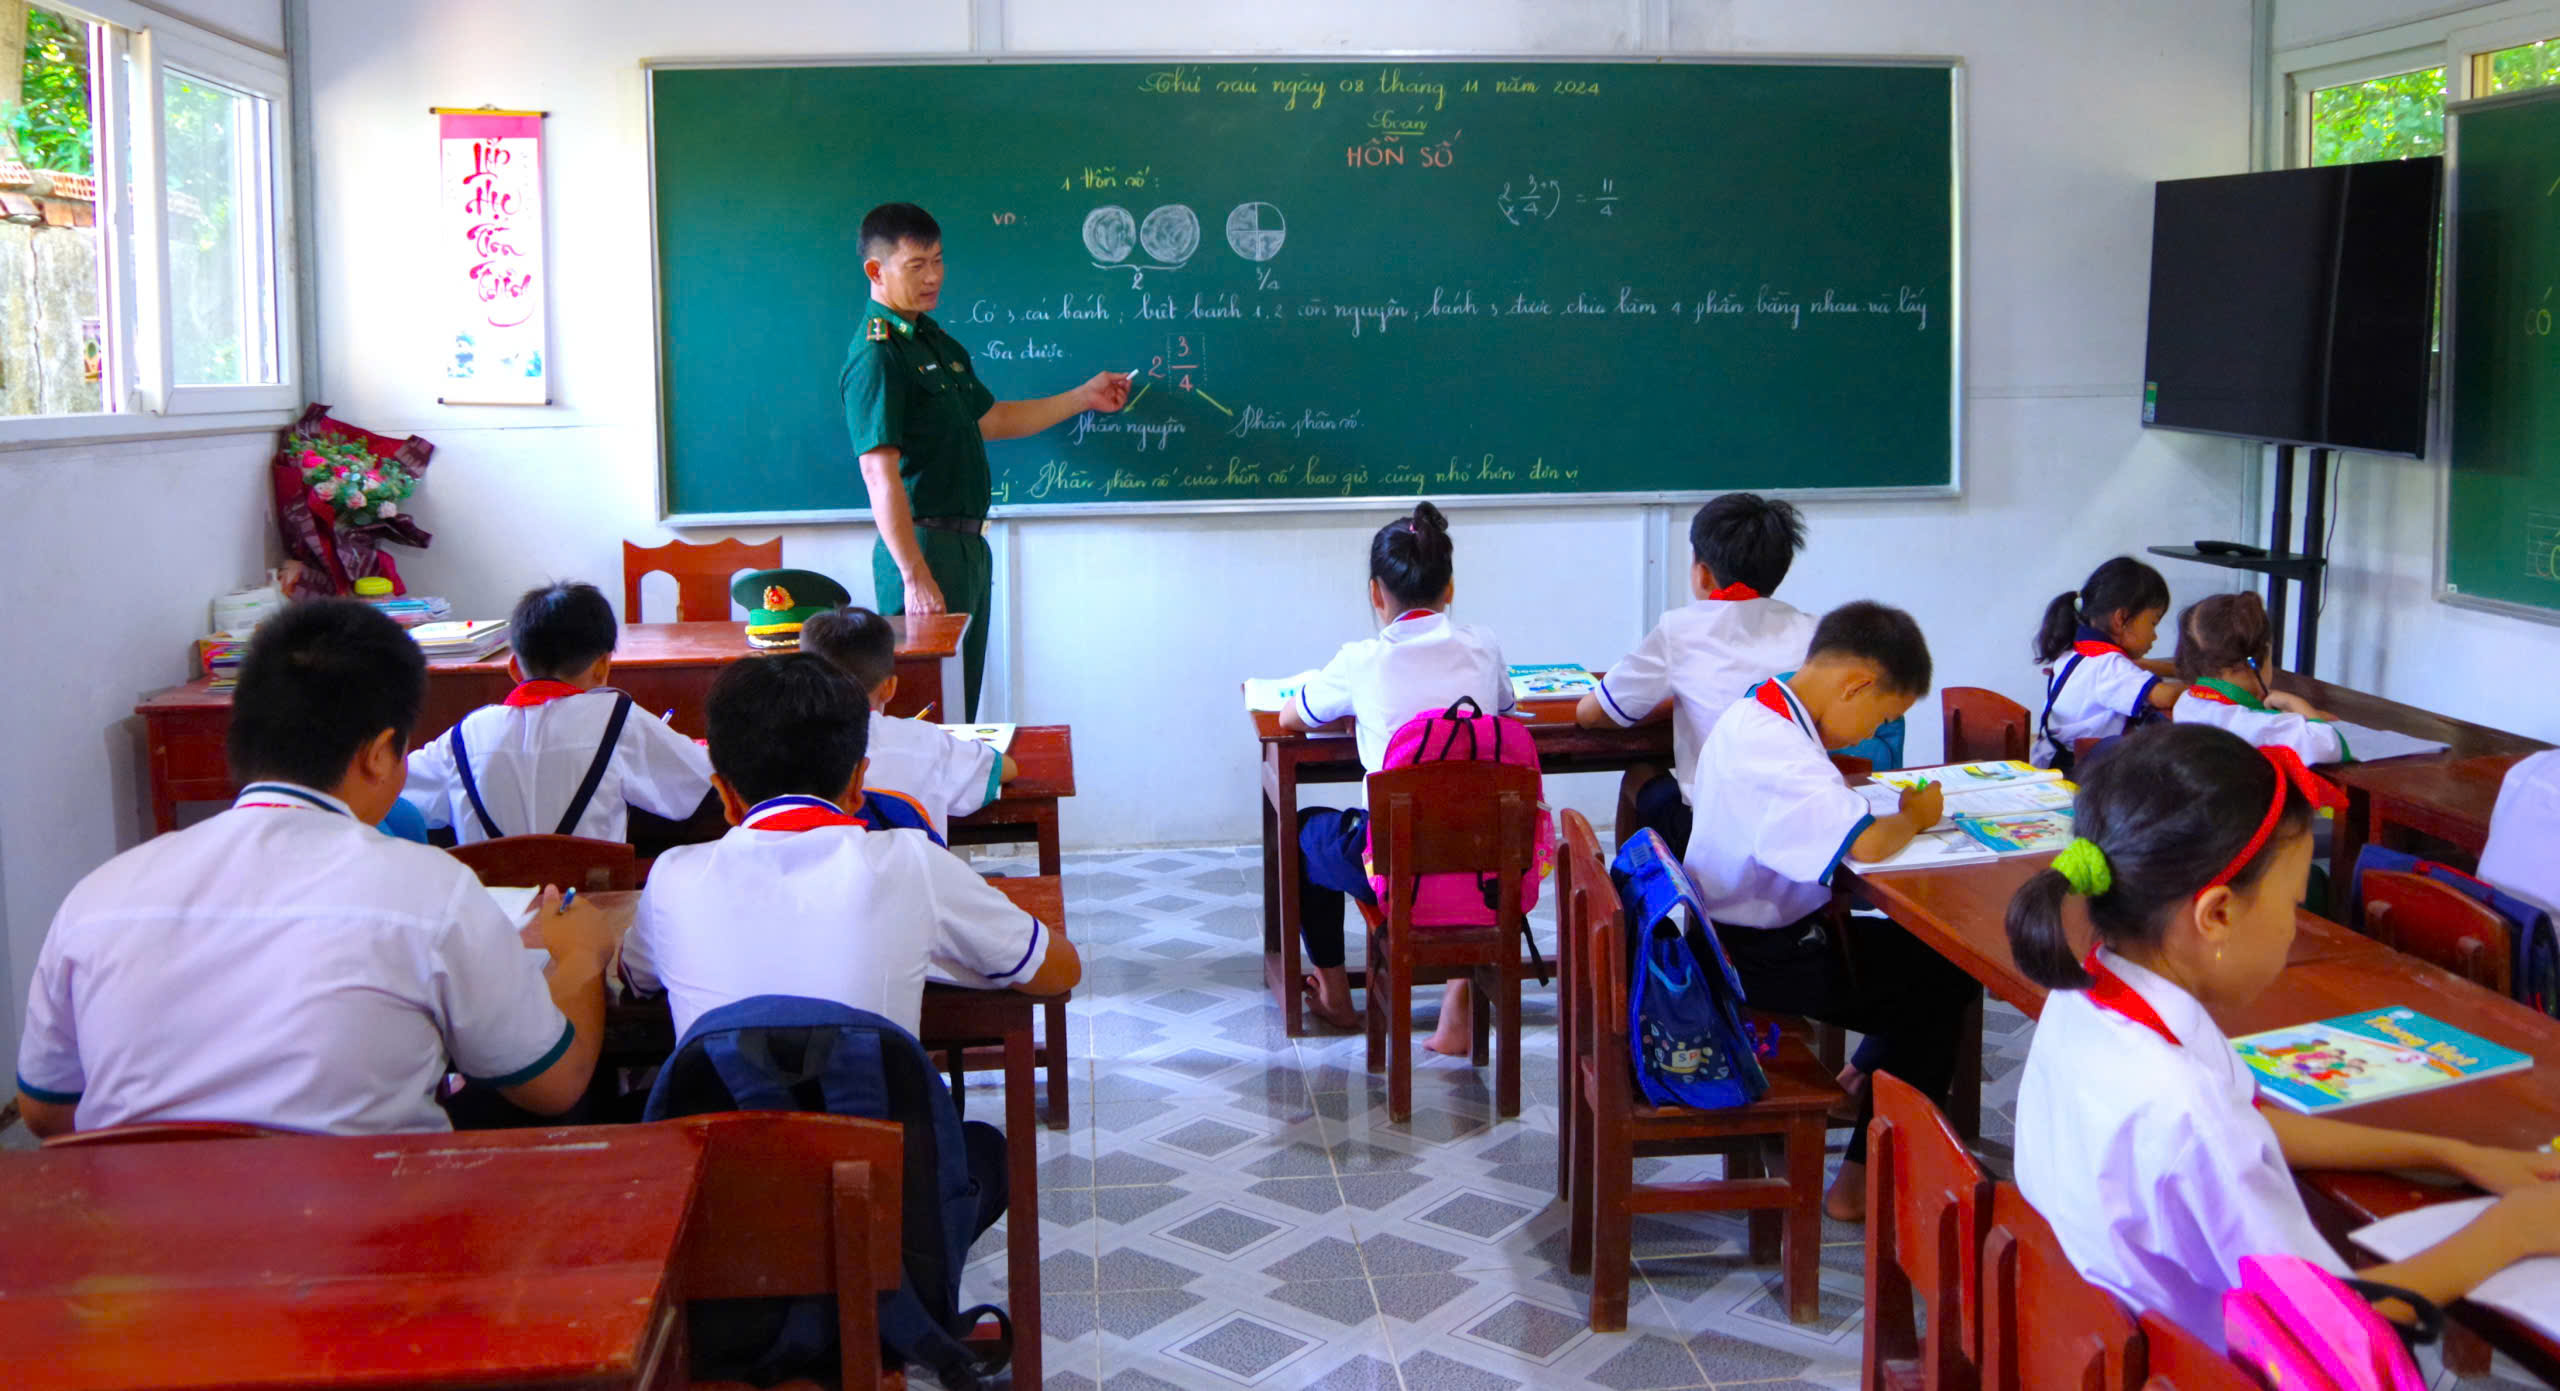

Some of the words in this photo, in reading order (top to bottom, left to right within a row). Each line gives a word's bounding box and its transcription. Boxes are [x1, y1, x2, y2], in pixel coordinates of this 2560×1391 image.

[1340, 80, 1364, 93] 08
[1376, 67, 1445, 111] tháng
[1496, 76, 1539, 93] năm
[1553, 81, 1600, 95] 2024
[1347, 136, 1405, 168] HỖN
[1420, 129, 1462, 168] SỐ
[1131, 272, 1144, 290] 2
[1178, 336, 1190, 358] 3
[1149, 356, 1167, 378] 2
[1179, 374, 1194, 393] 4
